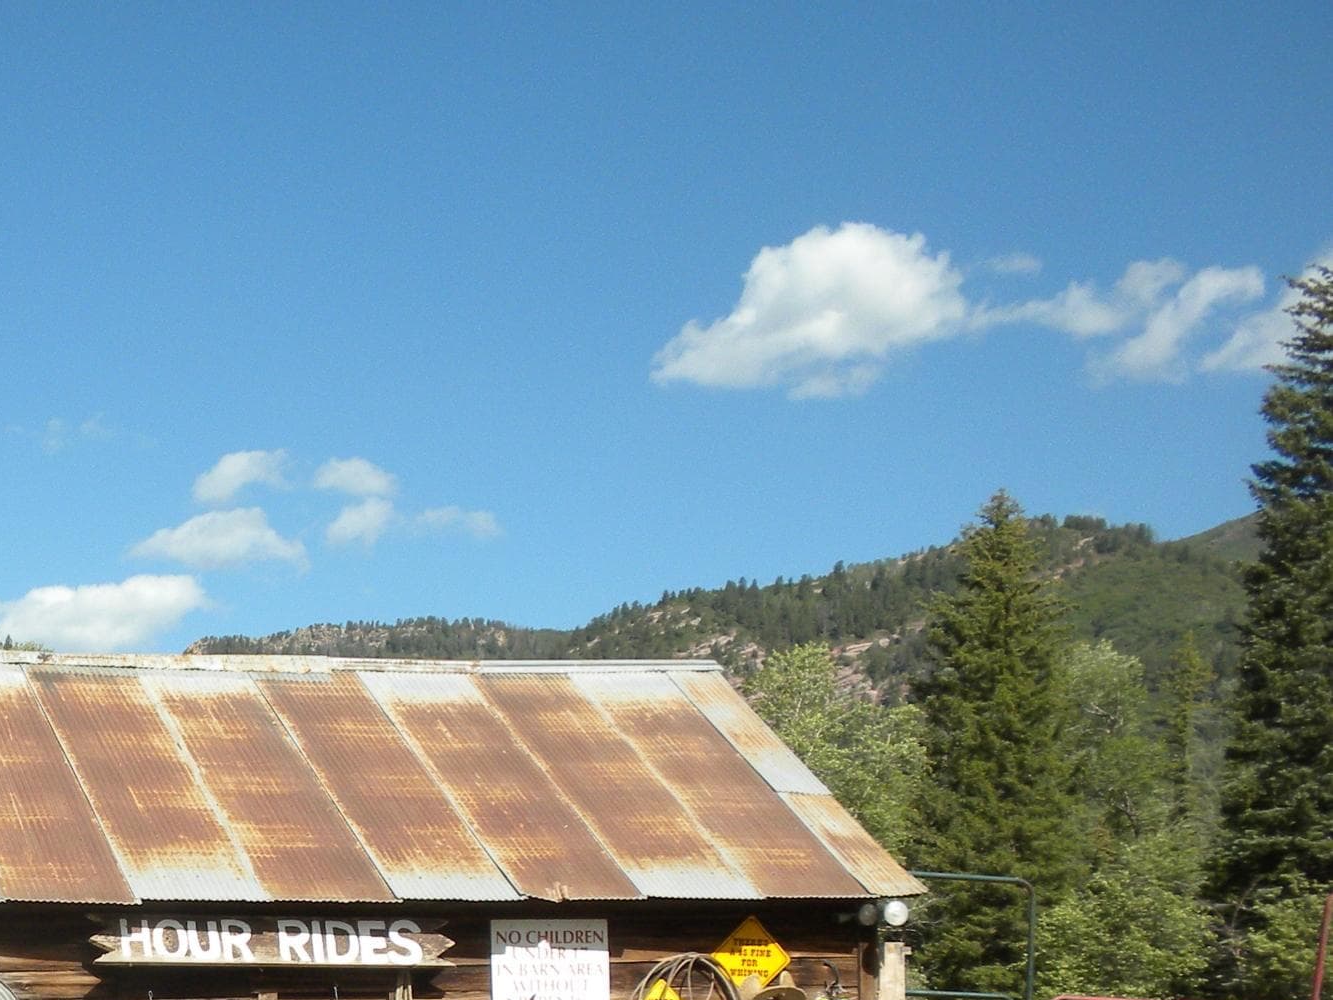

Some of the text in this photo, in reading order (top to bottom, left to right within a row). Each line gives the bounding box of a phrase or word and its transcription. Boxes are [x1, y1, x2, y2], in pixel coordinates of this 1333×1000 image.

[119, 918, 424, 965] HOUR RIDES
[496, 930, 604, 944] NO CHILDREN
[512, 946, 566, 959] UNDER
[751, 949, 771, 957] FINE
[497, 963, 604, 976] IN BARN AREA
[741, 959, 757, 967] FOR
[513, 979, 588, 992] WITHOUT
